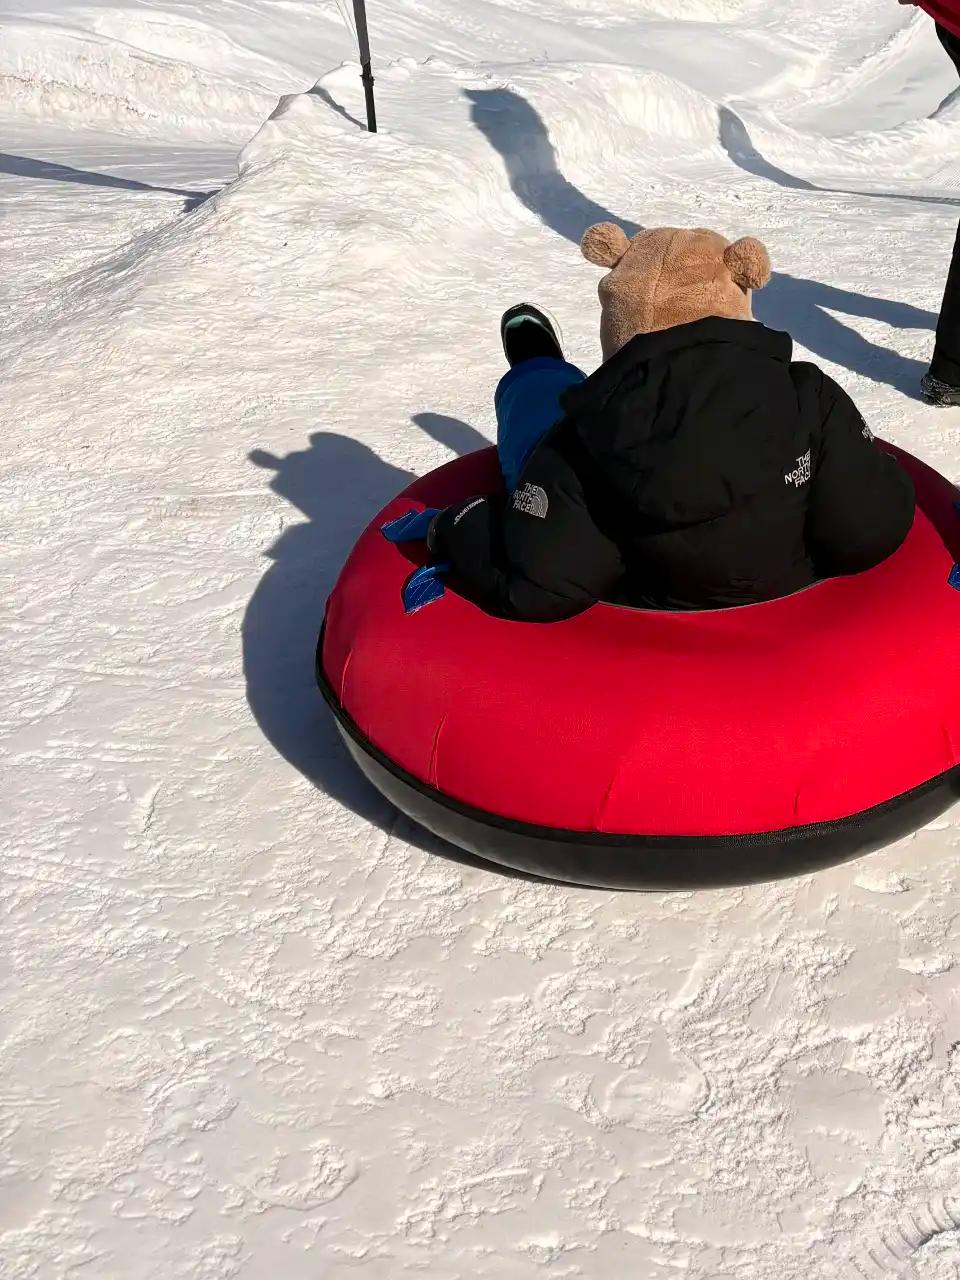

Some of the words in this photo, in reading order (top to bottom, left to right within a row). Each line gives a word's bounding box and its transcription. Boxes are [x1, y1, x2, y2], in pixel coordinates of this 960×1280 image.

[795, 448, 811, 466] THE
[794, 471, 811, 488] FAC
[525, 482, 538, 495] THE
[512, 499, 533, 513] FACE
